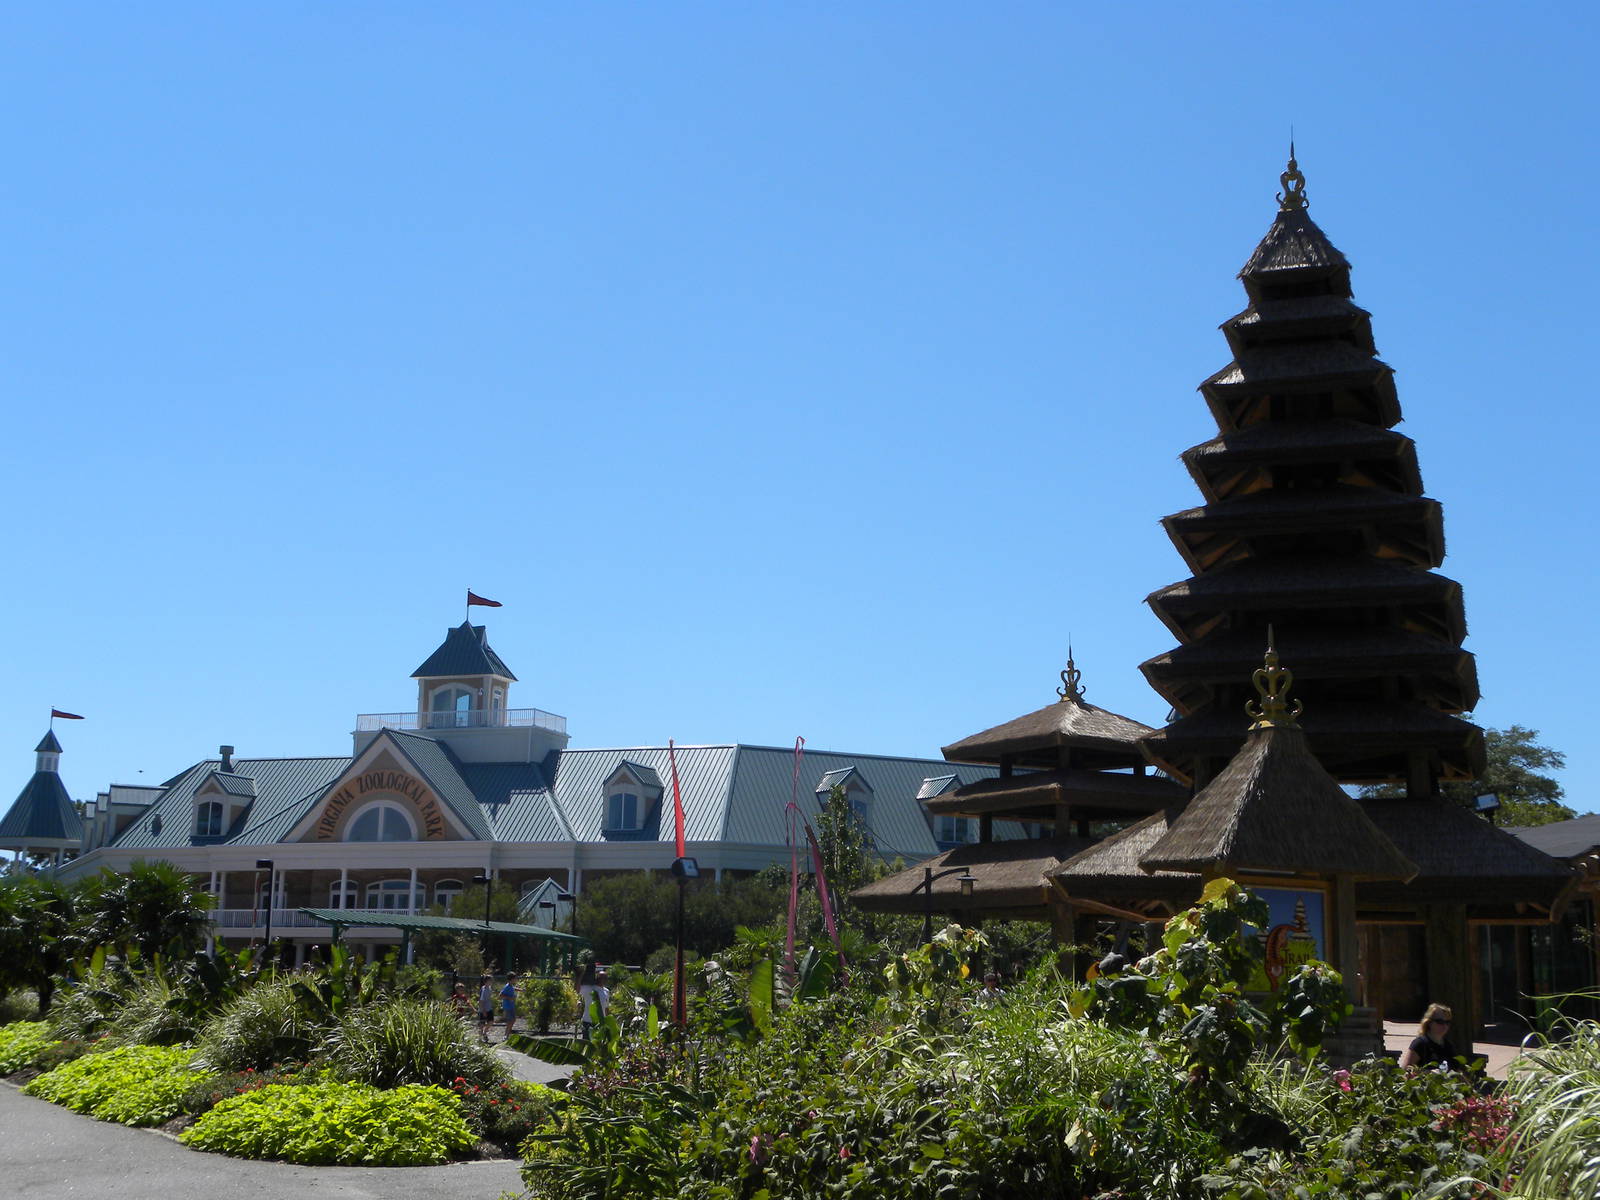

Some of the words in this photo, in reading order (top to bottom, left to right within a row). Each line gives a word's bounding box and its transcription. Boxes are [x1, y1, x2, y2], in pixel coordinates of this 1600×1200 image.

[318, 788, 355, 839] VIRGINIA
[357, 772, 425, 805] ZOOLOGICAL
[420, 800, 442, 838] PARK
